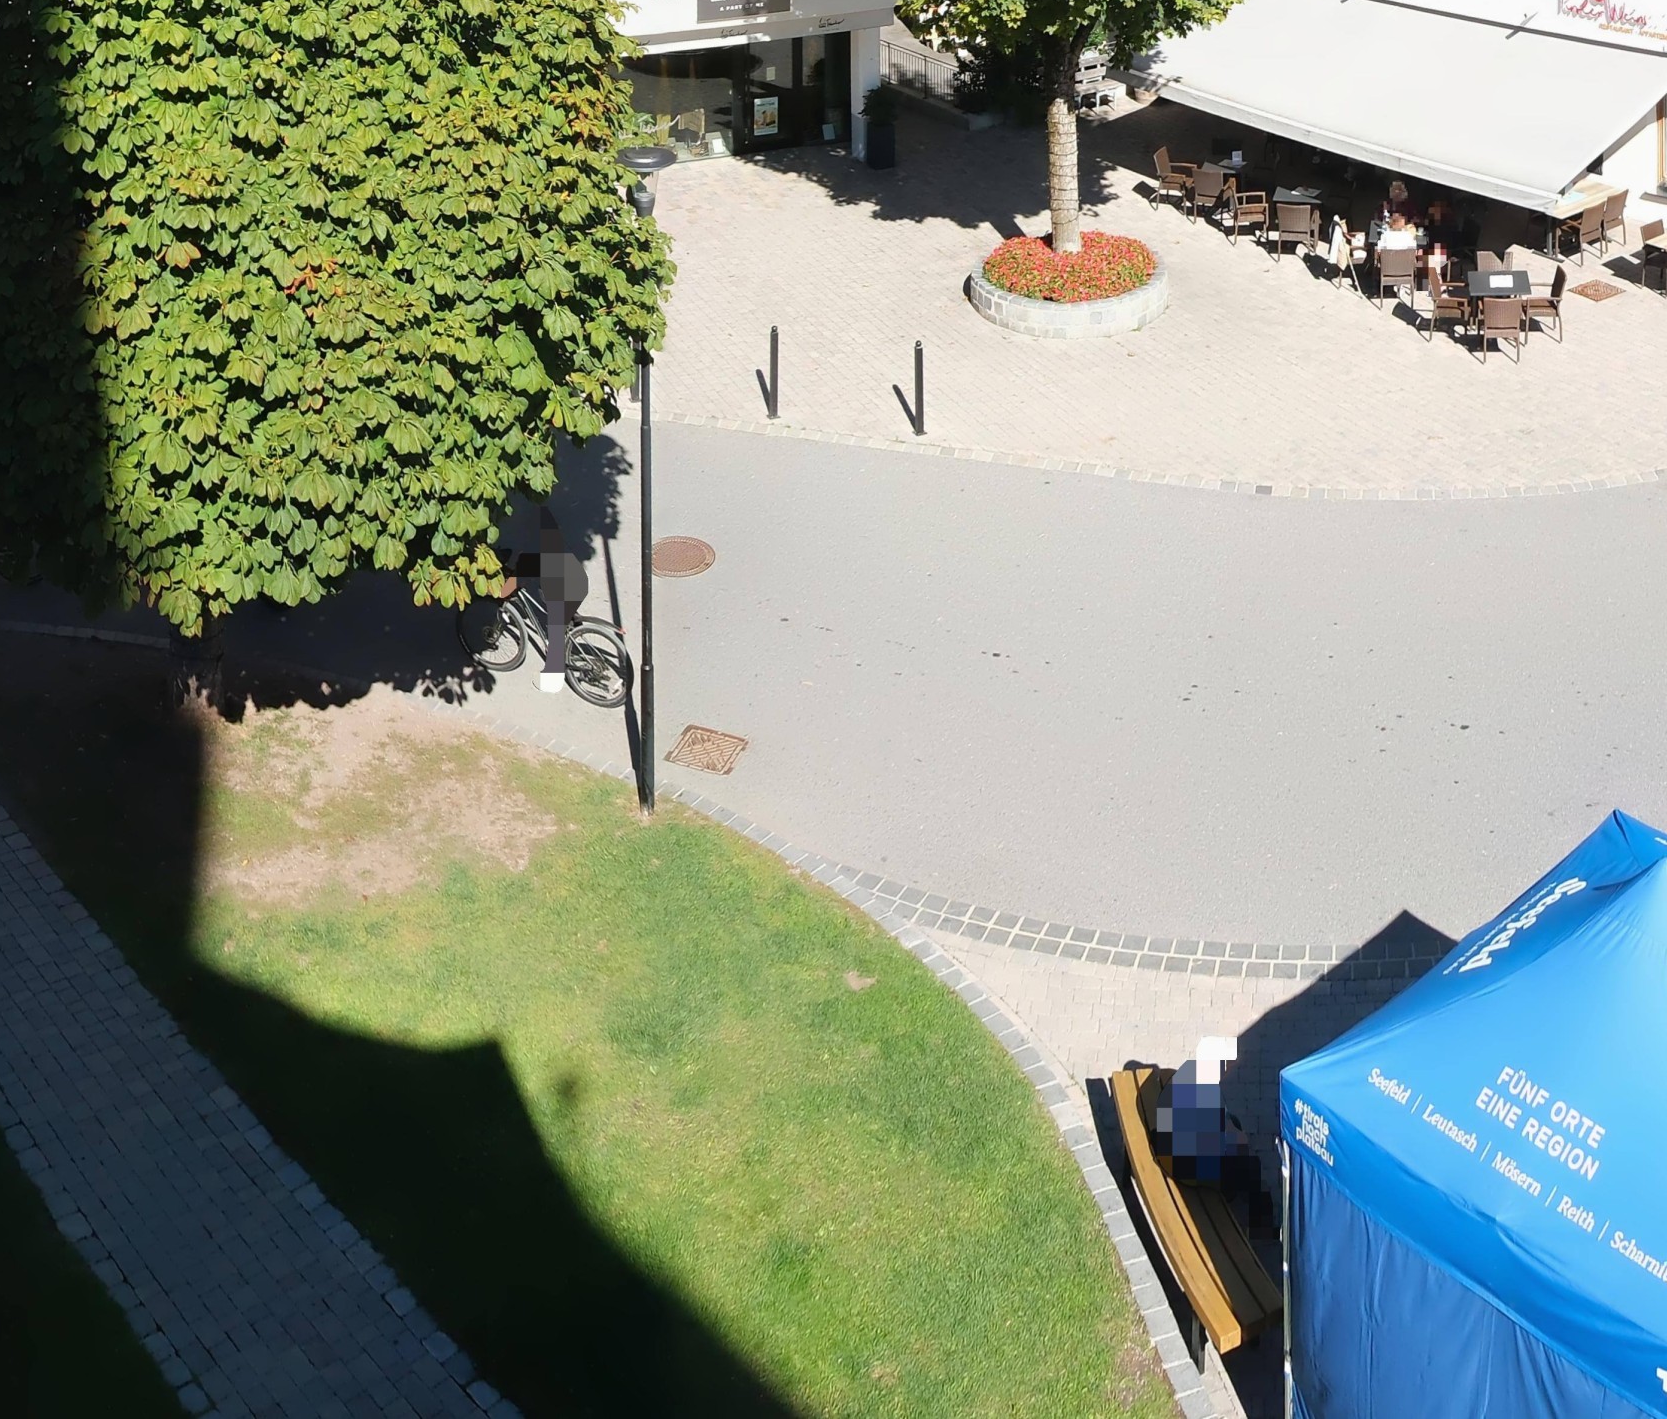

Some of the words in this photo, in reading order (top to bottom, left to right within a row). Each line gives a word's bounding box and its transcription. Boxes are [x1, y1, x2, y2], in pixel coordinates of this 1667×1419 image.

[1294, 1098, 1330, 1135] #tirols
[1302, 1116, 1327, 1148] hoch
[1476, 1086, 1518, 1129] EINE
[1522, 1117, 1601, 1181] REGION
[1497, 1066, 1550, 1109] FÜNF
[1549, 1099, 1606, 1148] ORTE
[1296, 1126, 1334, 1167] plateau
[1367, 1068, 1411, 1105] Seefeld
[1422, 1103, 1478, 1152] Leutasch
[1491, 1151, 1543, 1196] Mösern
[1556, 1195, 1595, 1232] Reith
